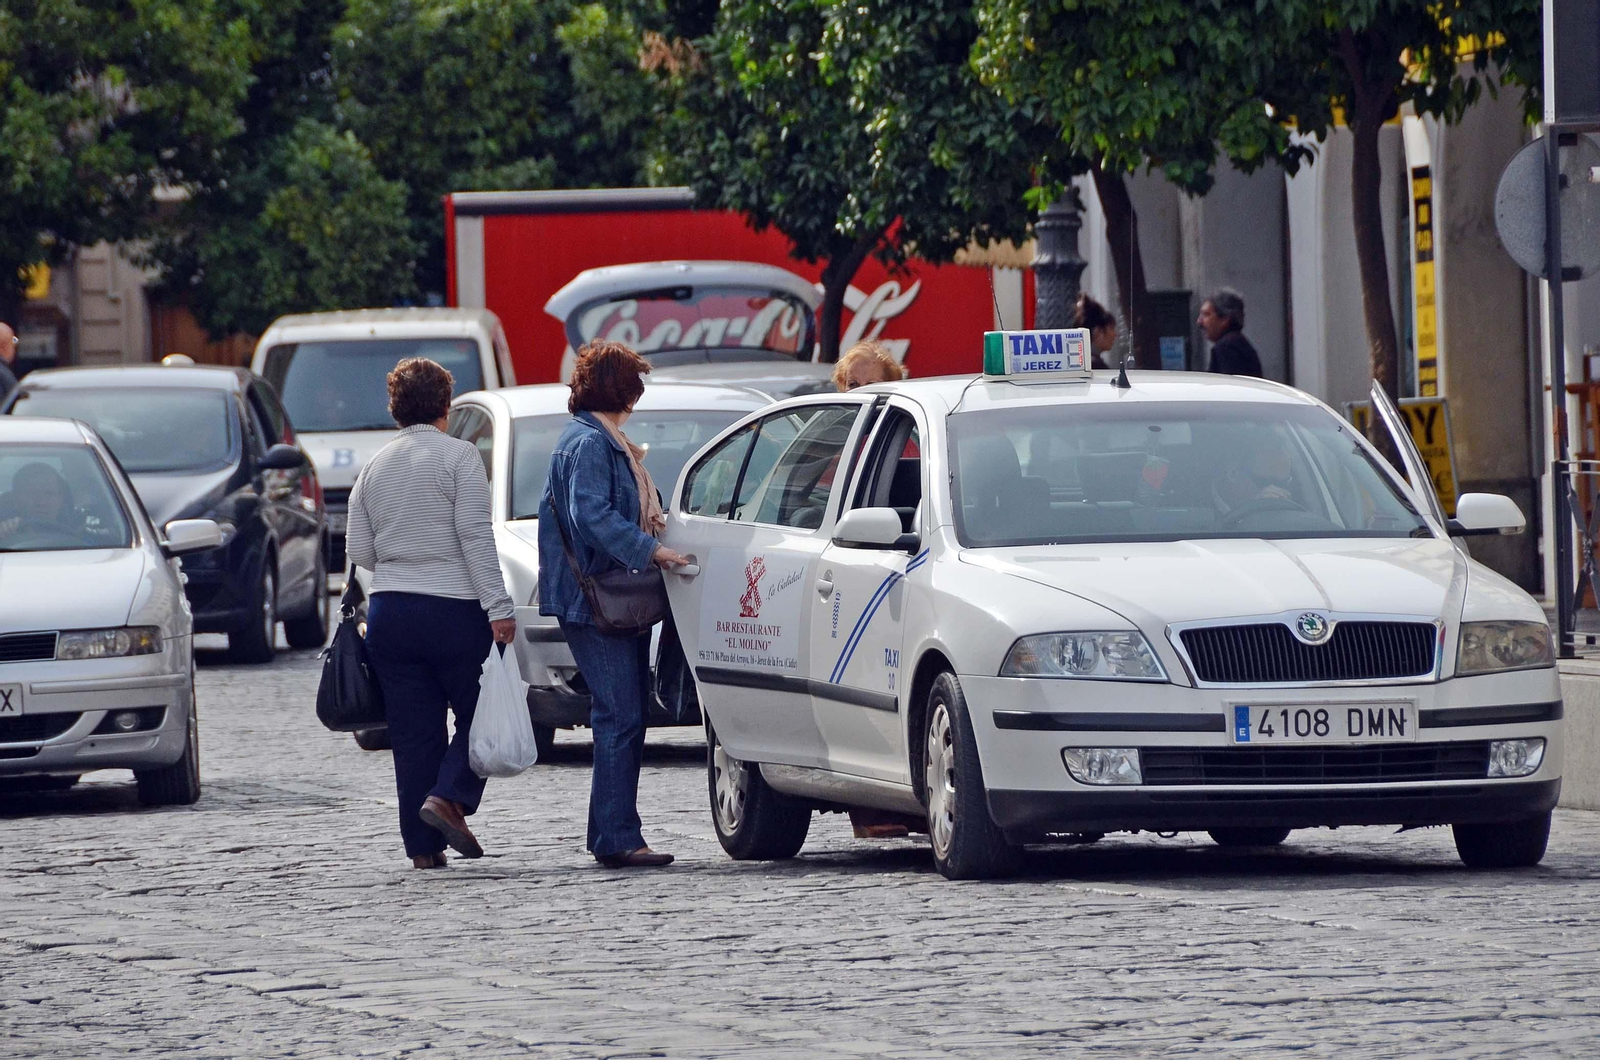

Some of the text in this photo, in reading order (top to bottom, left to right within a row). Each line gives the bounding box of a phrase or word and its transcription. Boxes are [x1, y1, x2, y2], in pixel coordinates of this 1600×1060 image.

[1008, 333, 1063, 355] TAXI
[1022, 360, 1062, 371] JEREZ
[777, 566, 804, 592] Calidad
[716, 620, 782, 637] BAR RESTAURANTE
[884, 647, 900, 669] TAXI
[1239, 707, 1407, 738] E 4108 DMN
